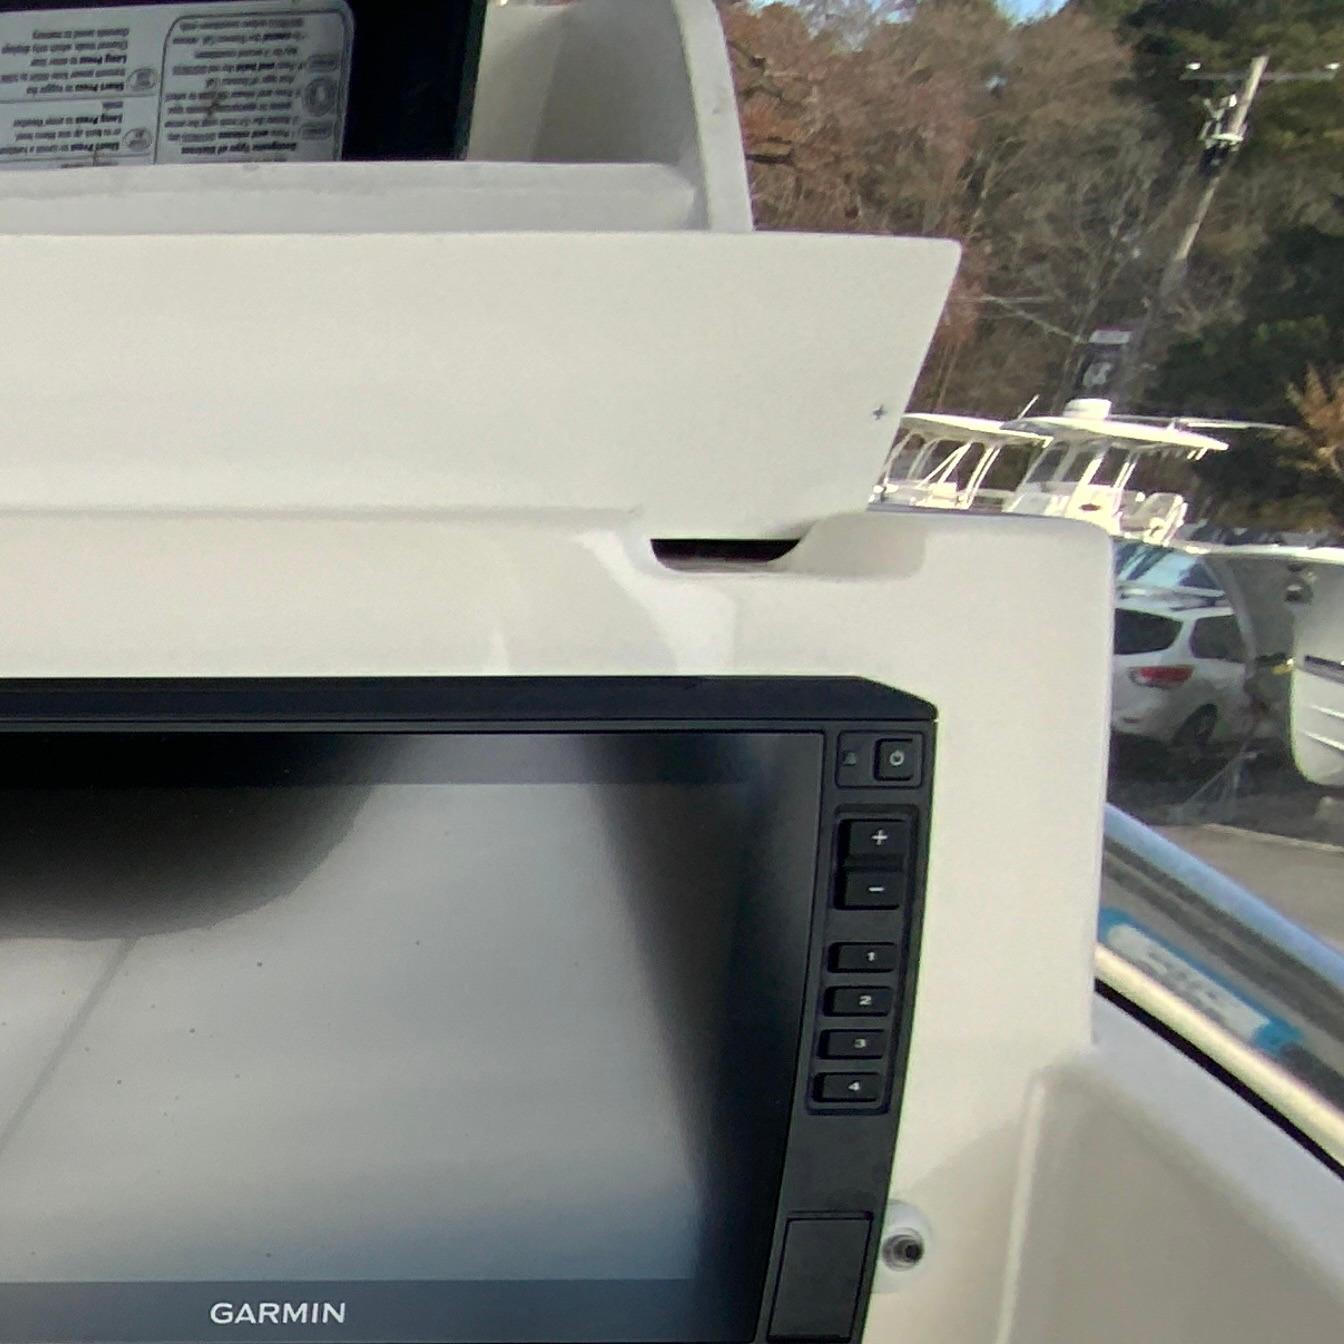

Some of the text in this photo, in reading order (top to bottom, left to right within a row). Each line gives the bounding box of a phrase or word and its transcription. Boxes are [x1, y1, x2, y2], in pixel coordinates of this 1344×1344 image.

[858, 994, 872, 1006] 2
[854, 1038, 867, 1049] 3
[847, 1080, 861, 1092] 4
[210, 1301, 346, 1325] GARMIN
